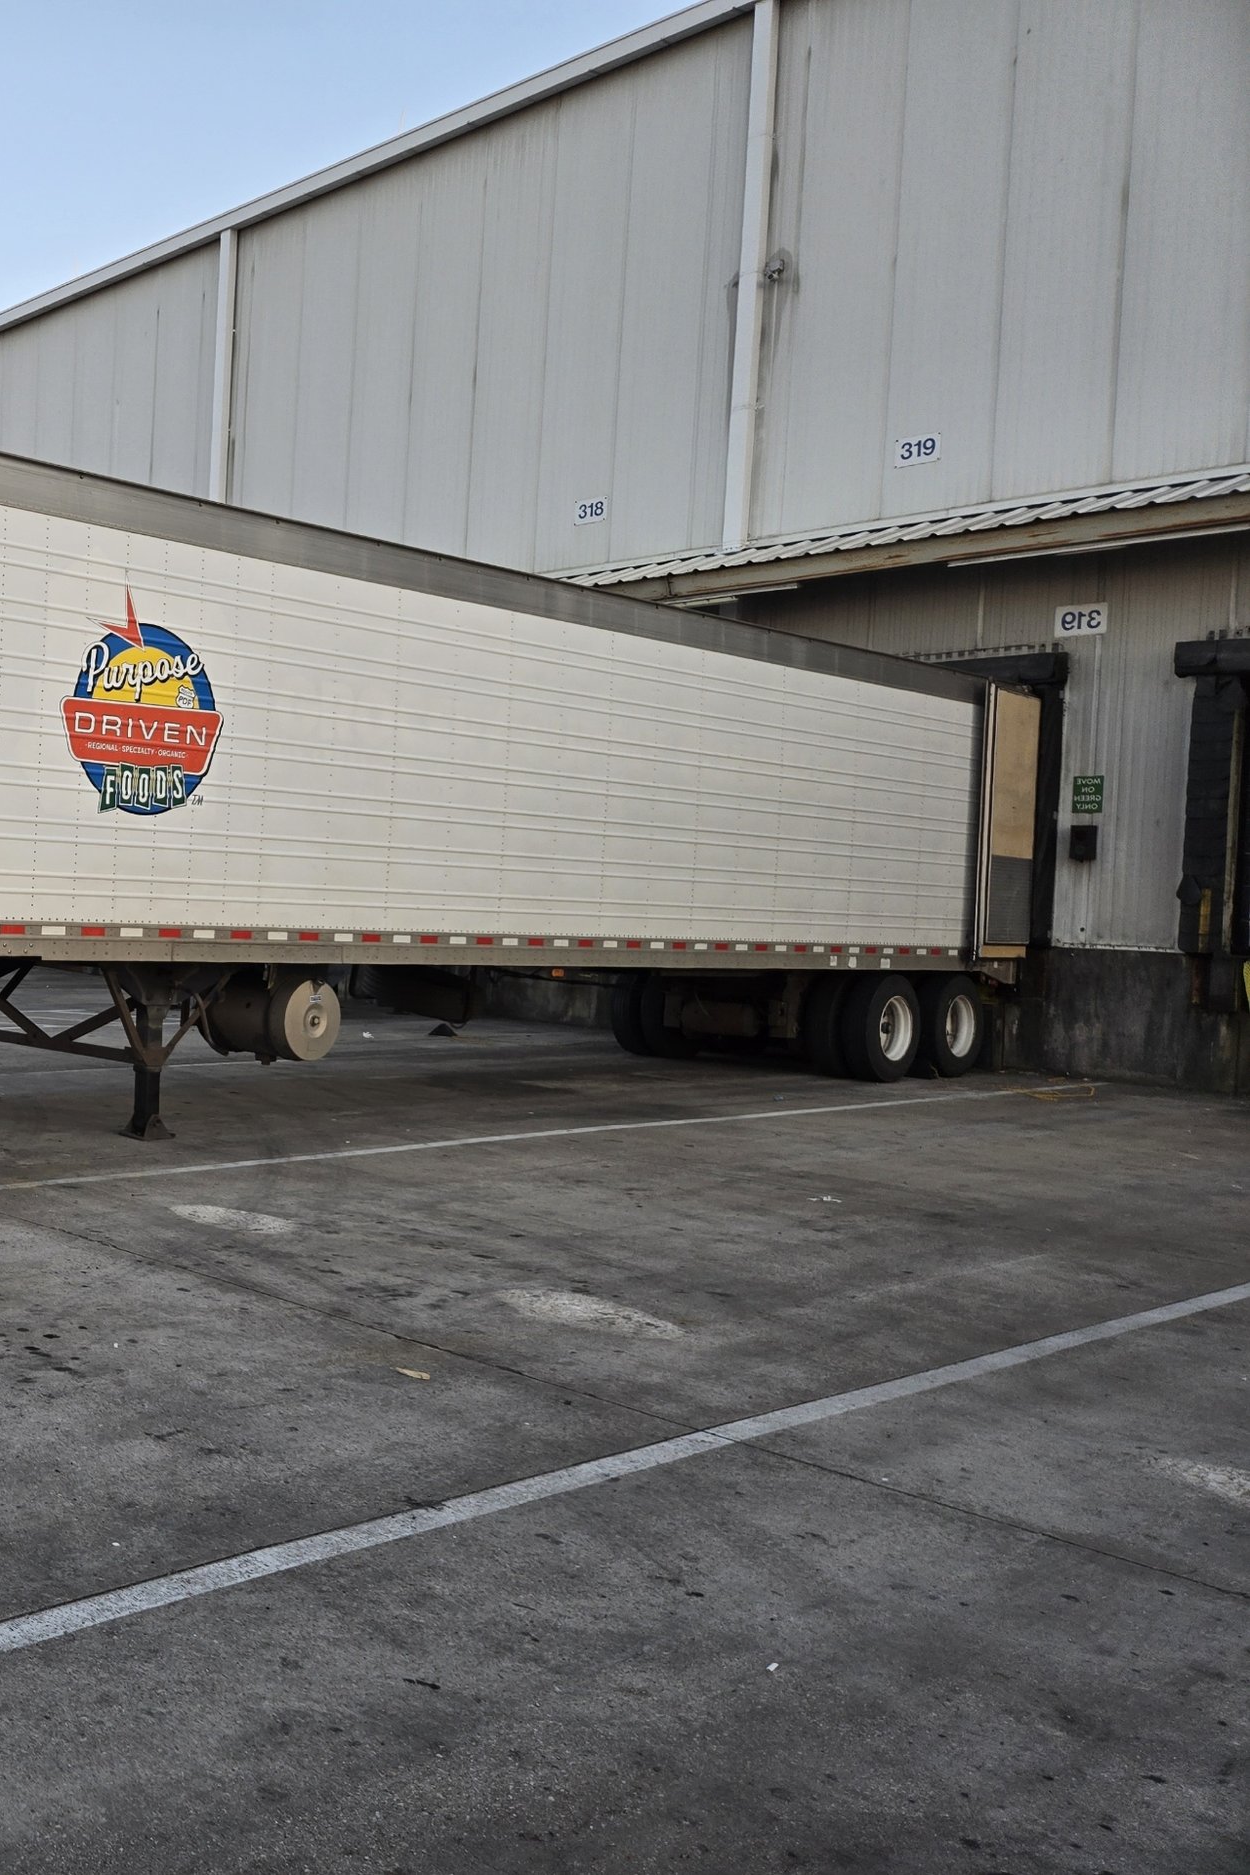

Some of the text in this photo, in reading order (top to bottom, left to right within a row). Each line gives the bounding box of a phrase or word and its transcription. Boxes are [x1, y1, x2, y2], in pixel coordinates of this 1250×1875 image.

[900, 437, 936, 460] 319
[577, 501, 604, 519] 318
[82, 641, 203, 701] Purpose
[178, 695, 193, 706] PDF
[74, 711, 207, 746] DRIVEN
[87, 742, 187, 759] REGIONAL SPECIALTY ORGANIC
[104, 769, 183, 805] FOODS
